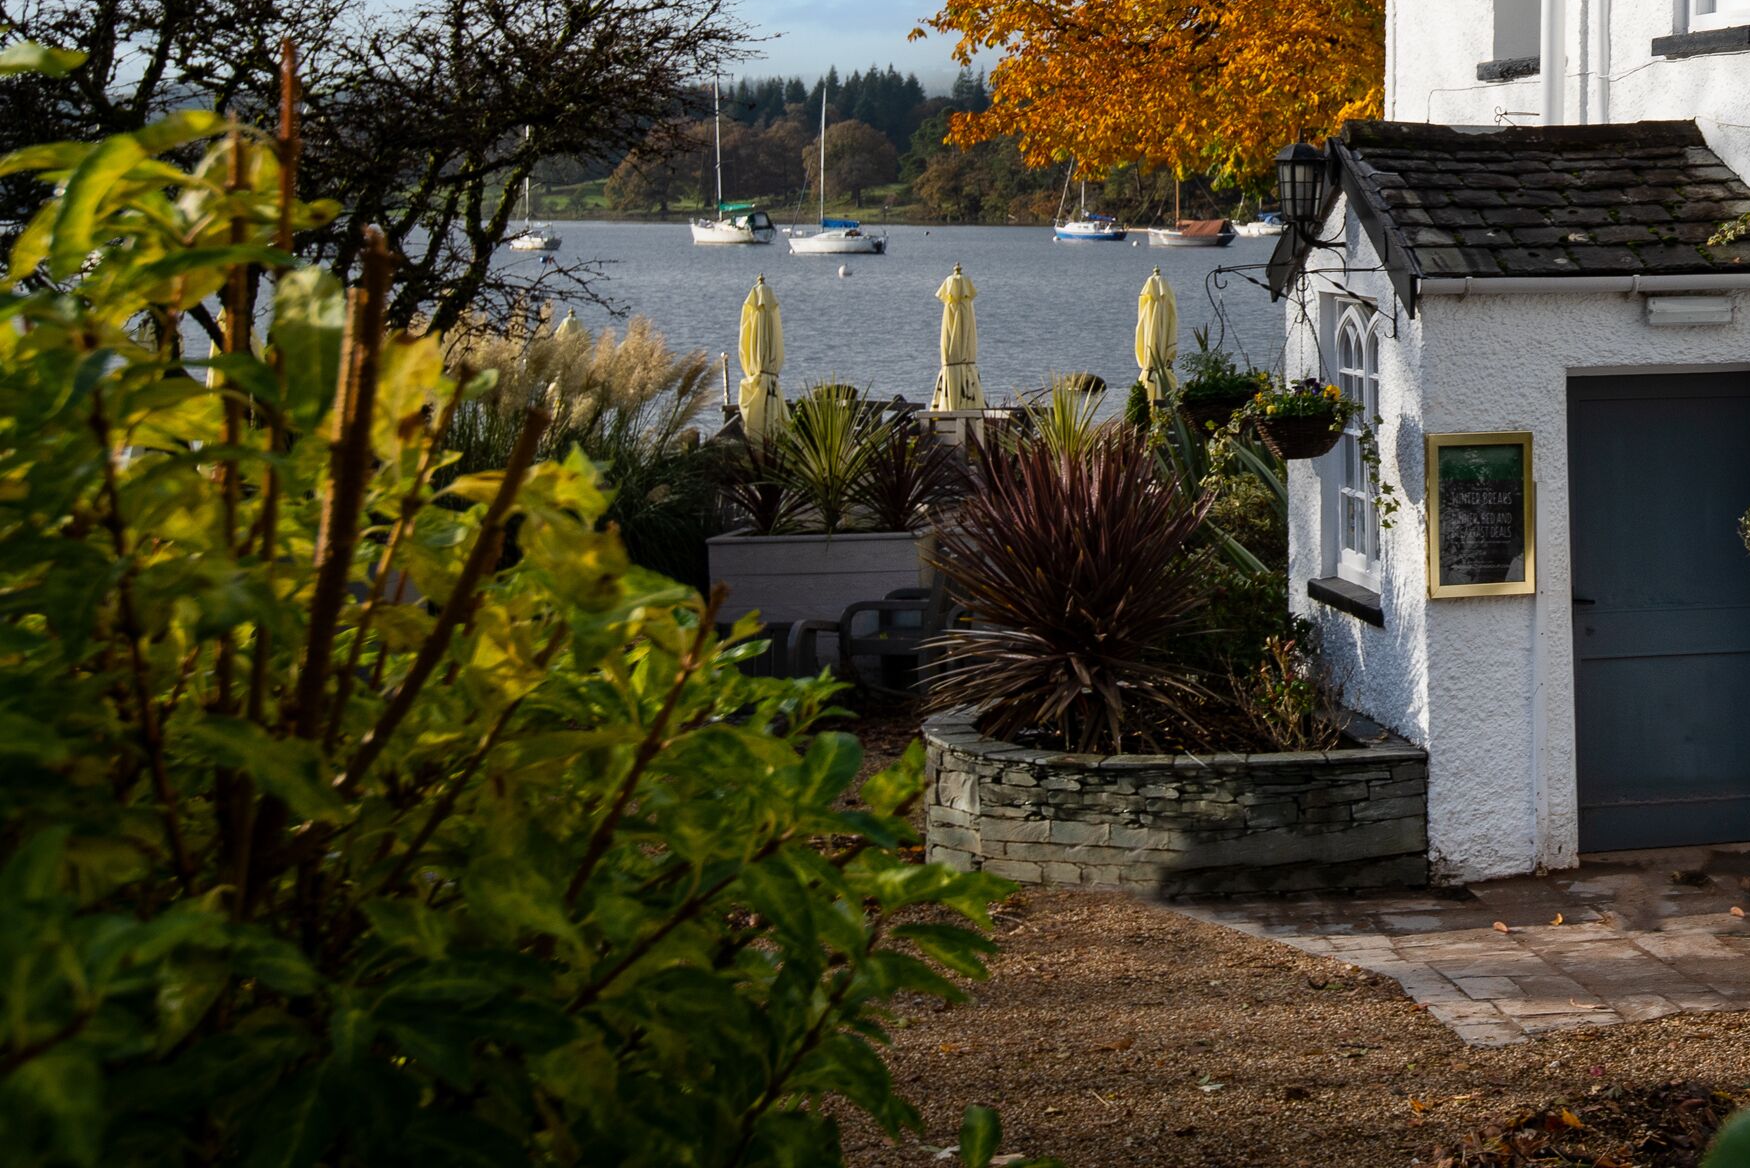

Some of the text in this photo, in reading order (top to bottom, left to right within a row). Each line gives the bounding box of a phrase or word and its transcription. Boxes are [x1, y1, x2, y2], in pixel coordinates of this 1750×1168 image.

[1482, 492, 1512, 505] BREAKS
[1496, 512, 1512, 525] AND
[1490, 526, 1512, 538] DEALS
